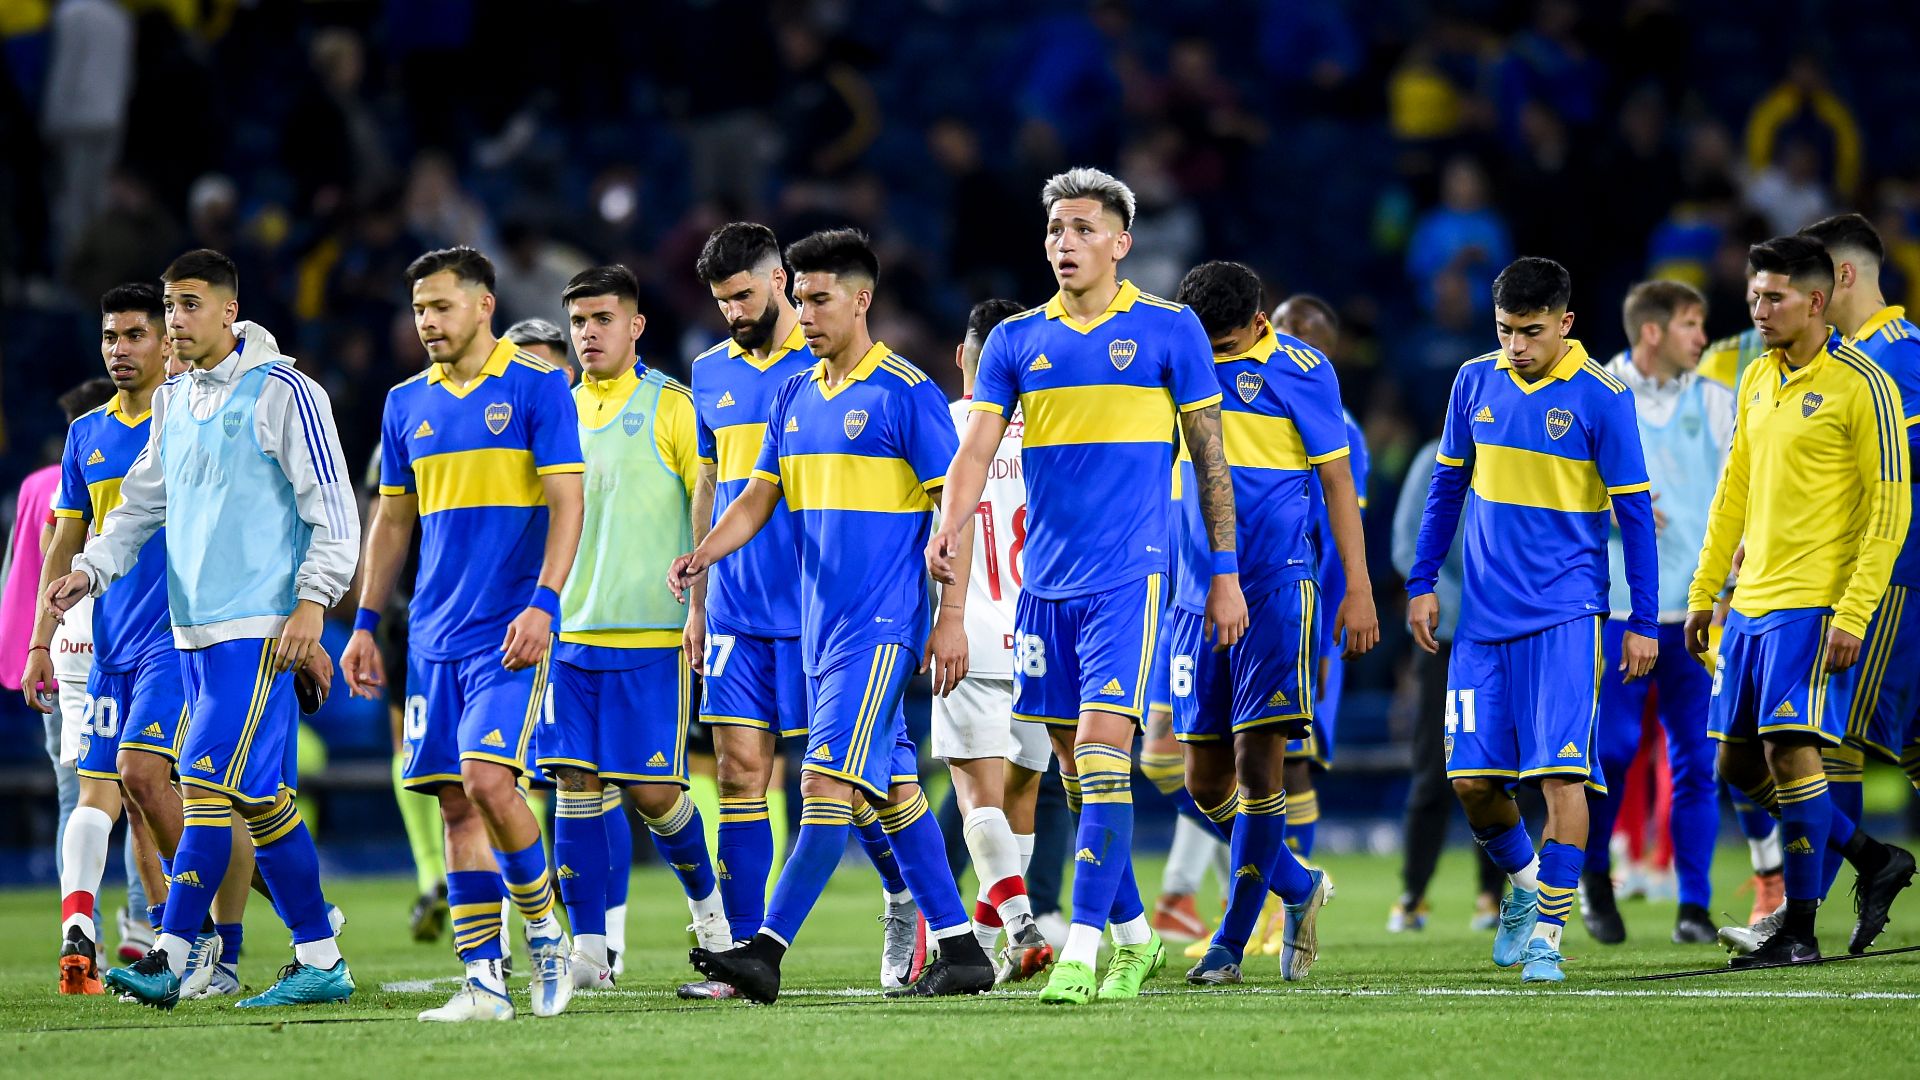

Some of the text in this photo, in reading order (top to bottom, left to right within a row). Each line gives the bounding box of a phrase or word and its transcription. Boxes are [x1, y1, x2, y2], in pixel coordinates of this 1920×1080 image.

[1548, 417, 1569, 427] CABJ
[1172, 655, 1194, 698] 6
[1099, 688, 1125, 697] adidas
[80, 693, 119, 738] 20
[1557, 751, 1583, 759] adidas
